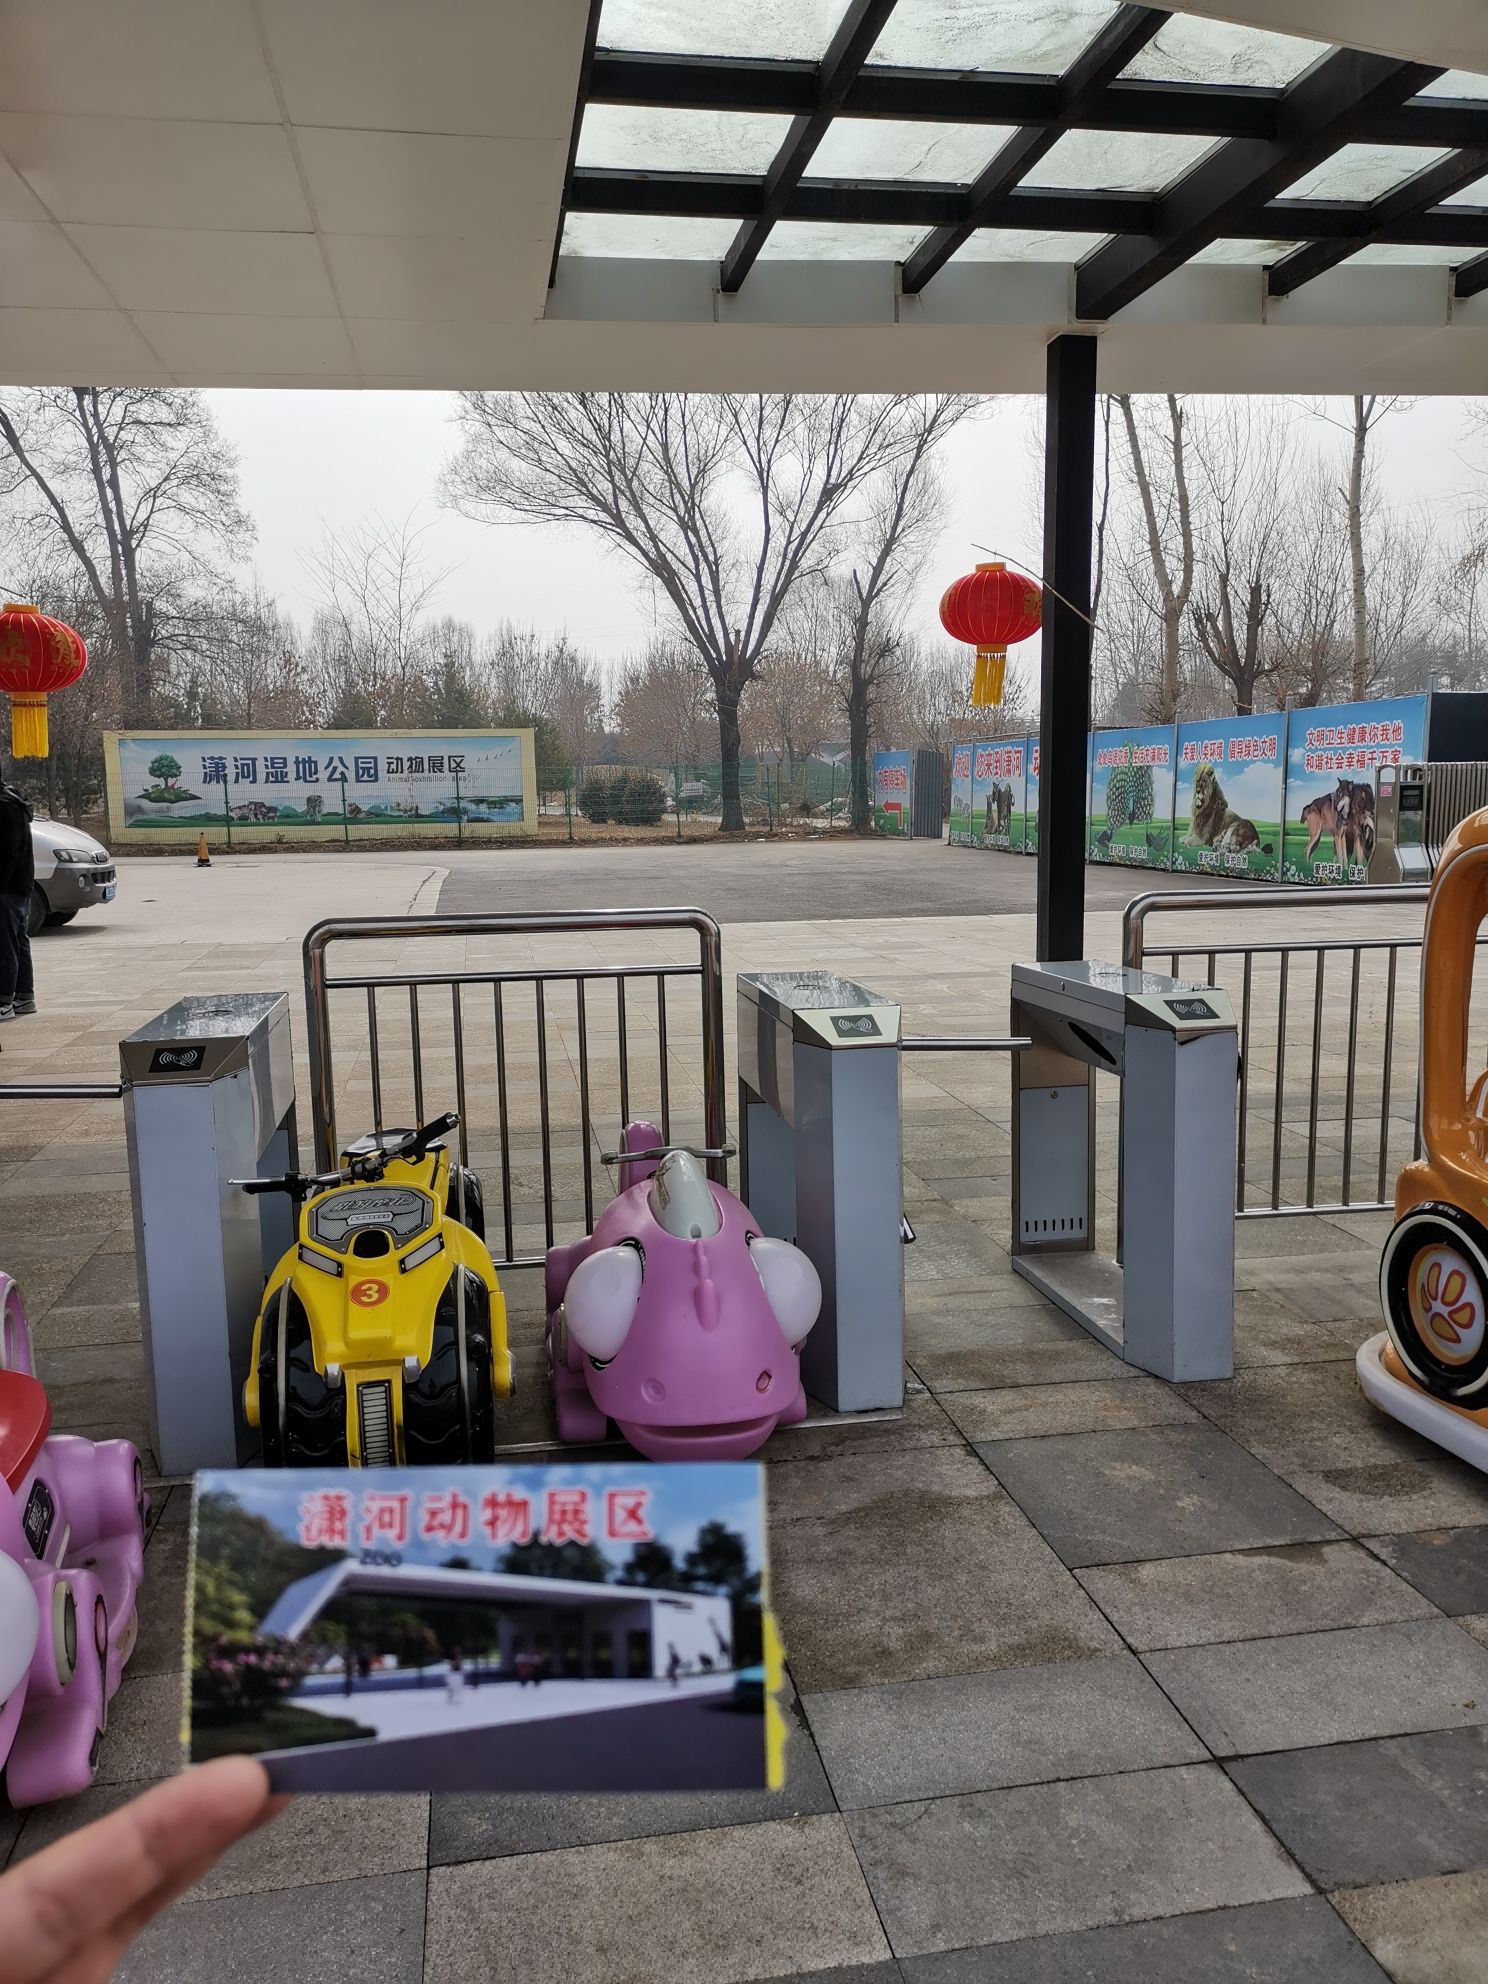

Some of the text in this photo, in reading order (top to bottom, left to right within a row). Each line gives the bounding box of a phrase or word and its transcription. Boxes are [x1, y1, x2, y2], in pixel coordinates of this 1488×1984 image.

[1306, 722, 1403, 748] 文明卫生健康你我他
[1182, 735, 1278, 762] 关爱人类环境 倡导绿色文明
[1305, 746, 1403, 772] 和谐社会幸福千万家
[201, 755, 466, 785] 潇河湿地公园 动物展区
[1197, 850, 1248, 868] 爱护环境 保护自然
[1313, 861, 1367, 881] 爱护环境 保护
[360, 1283, 380, 1303] 3
[299, 1488, 653, 1547] 潇河动物展区
